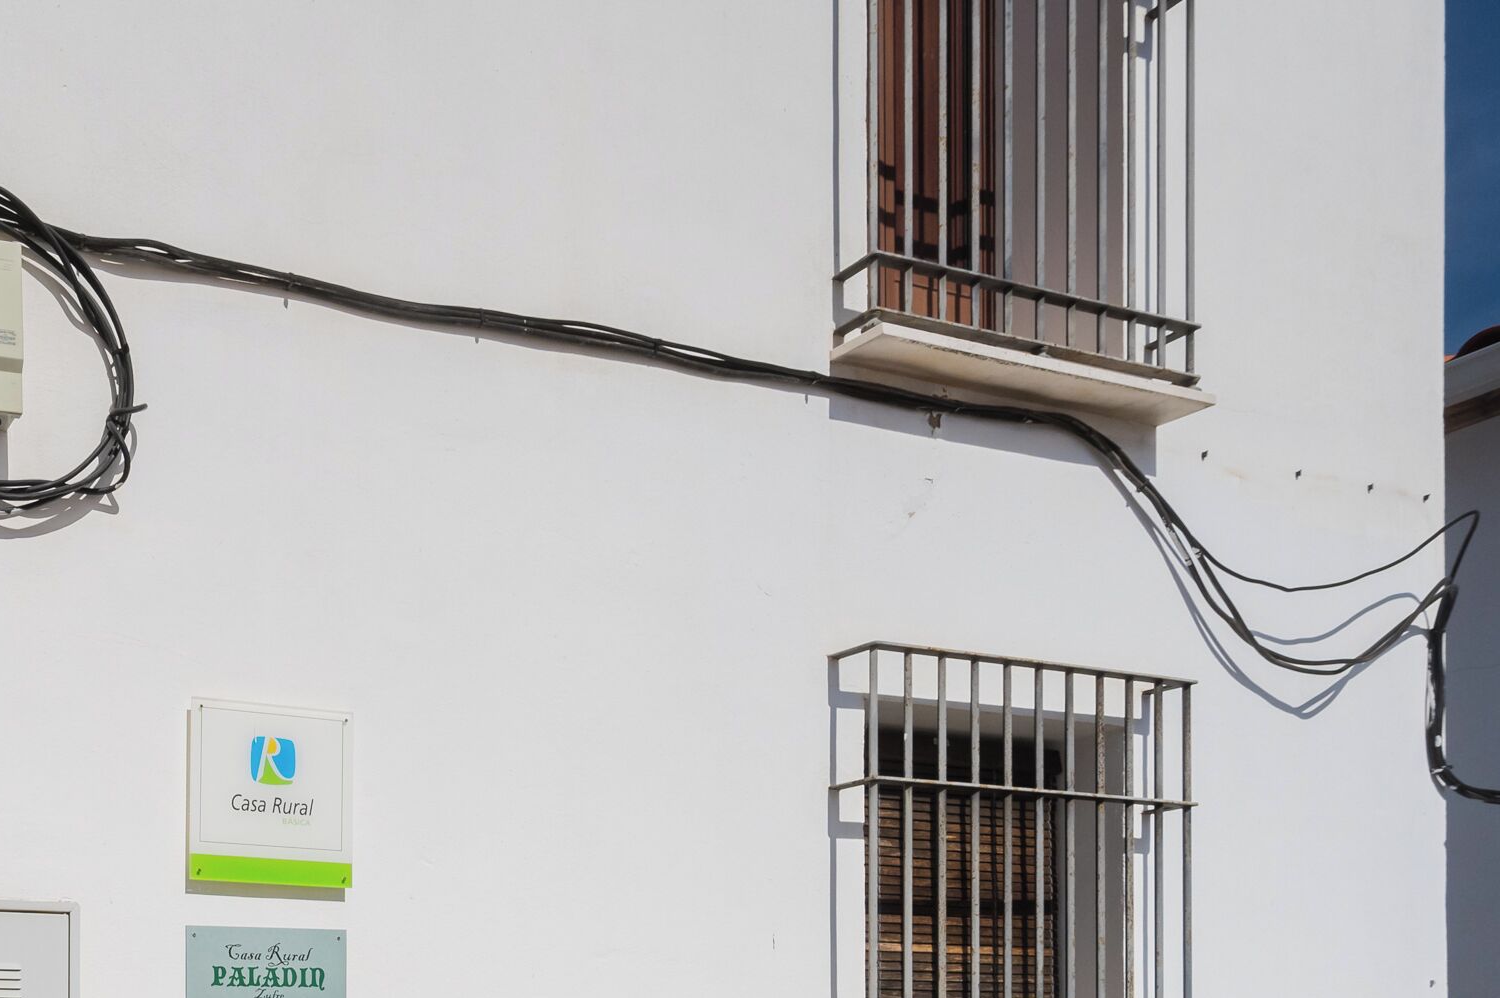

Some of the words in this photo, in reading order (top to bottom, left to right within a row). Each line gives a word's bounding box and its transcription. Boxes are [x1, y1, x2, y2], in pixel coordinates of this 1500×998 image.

[231, 793, 267, 813] Casa
[272, 797, 315, 817] Rural
[225, 943, 262, 961] Casa
[265, 942, 314, 967] Rural
[211, 965, 326, 991] PALADIN
